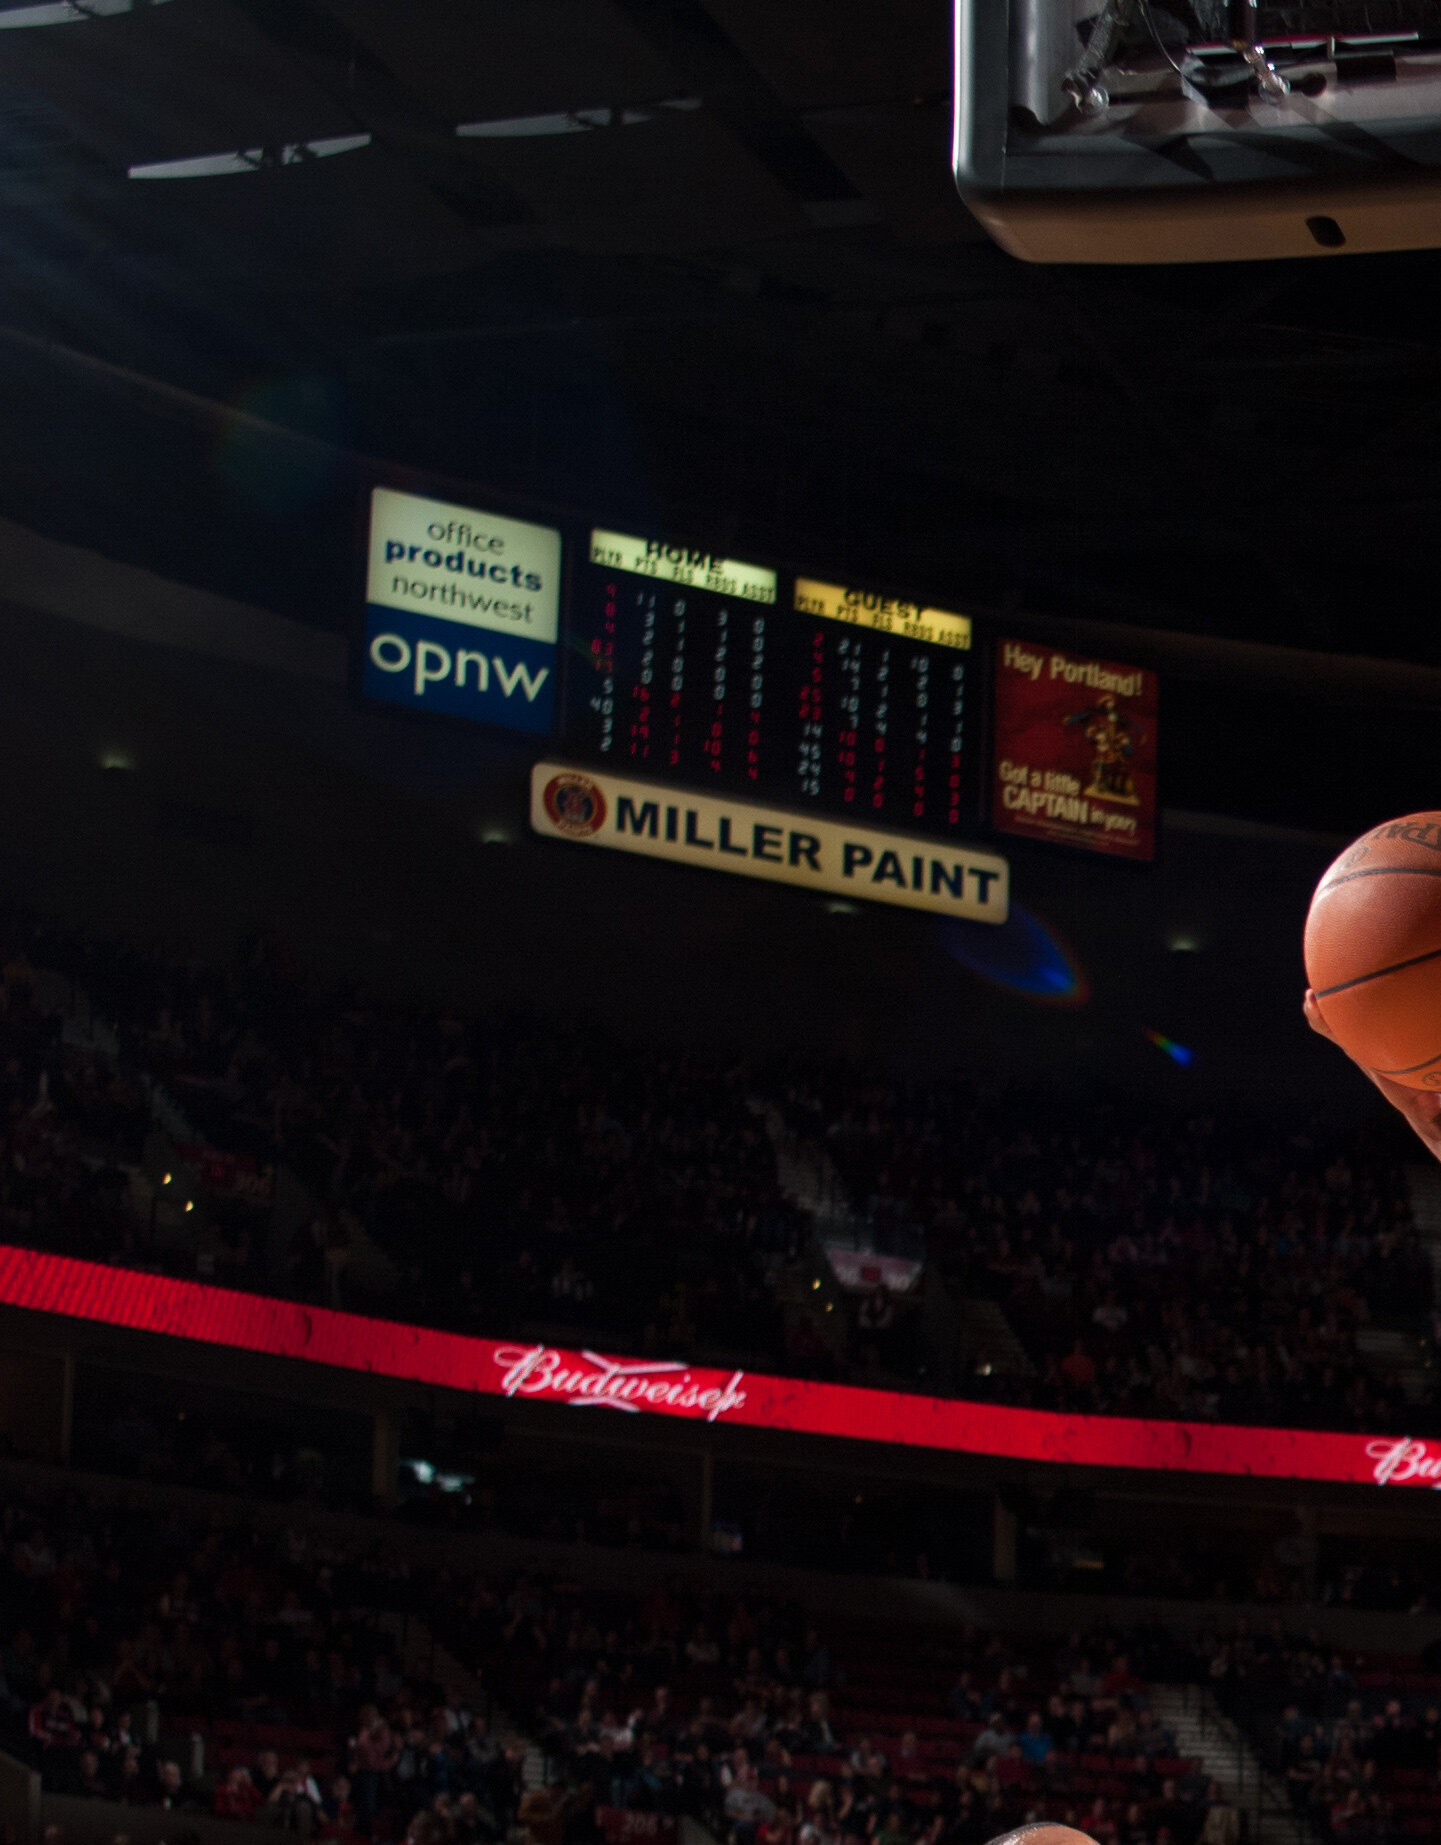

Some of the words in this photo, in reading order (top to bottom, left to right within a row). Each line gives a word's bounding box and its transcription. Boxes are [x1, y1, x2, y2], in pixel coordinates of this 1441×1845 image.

[428, 521, 504, 555] office
[646, 541, 725, 576] HOME
[386, 539, 542, 591] products
[392, 576, 534, 624] northwest
[844, 589, 922, 621] GUEST
[369, 631, 549, 703] opnw
[1003, 642, 1044, 681] Hey
[1051, 655, 1143, 697] Portland!
[1000, 758, 1029, 786] Got
[1029, 771, 1043, 788] a
[1044, 770, 1081, 797] little
[1003, 785, 1089, 824] CAPTAIN
[616, 795, 821, 872] MILLER
[842, 841, 998, 905] PAINT
[493, 1344, 747, 1423] Budweiser
